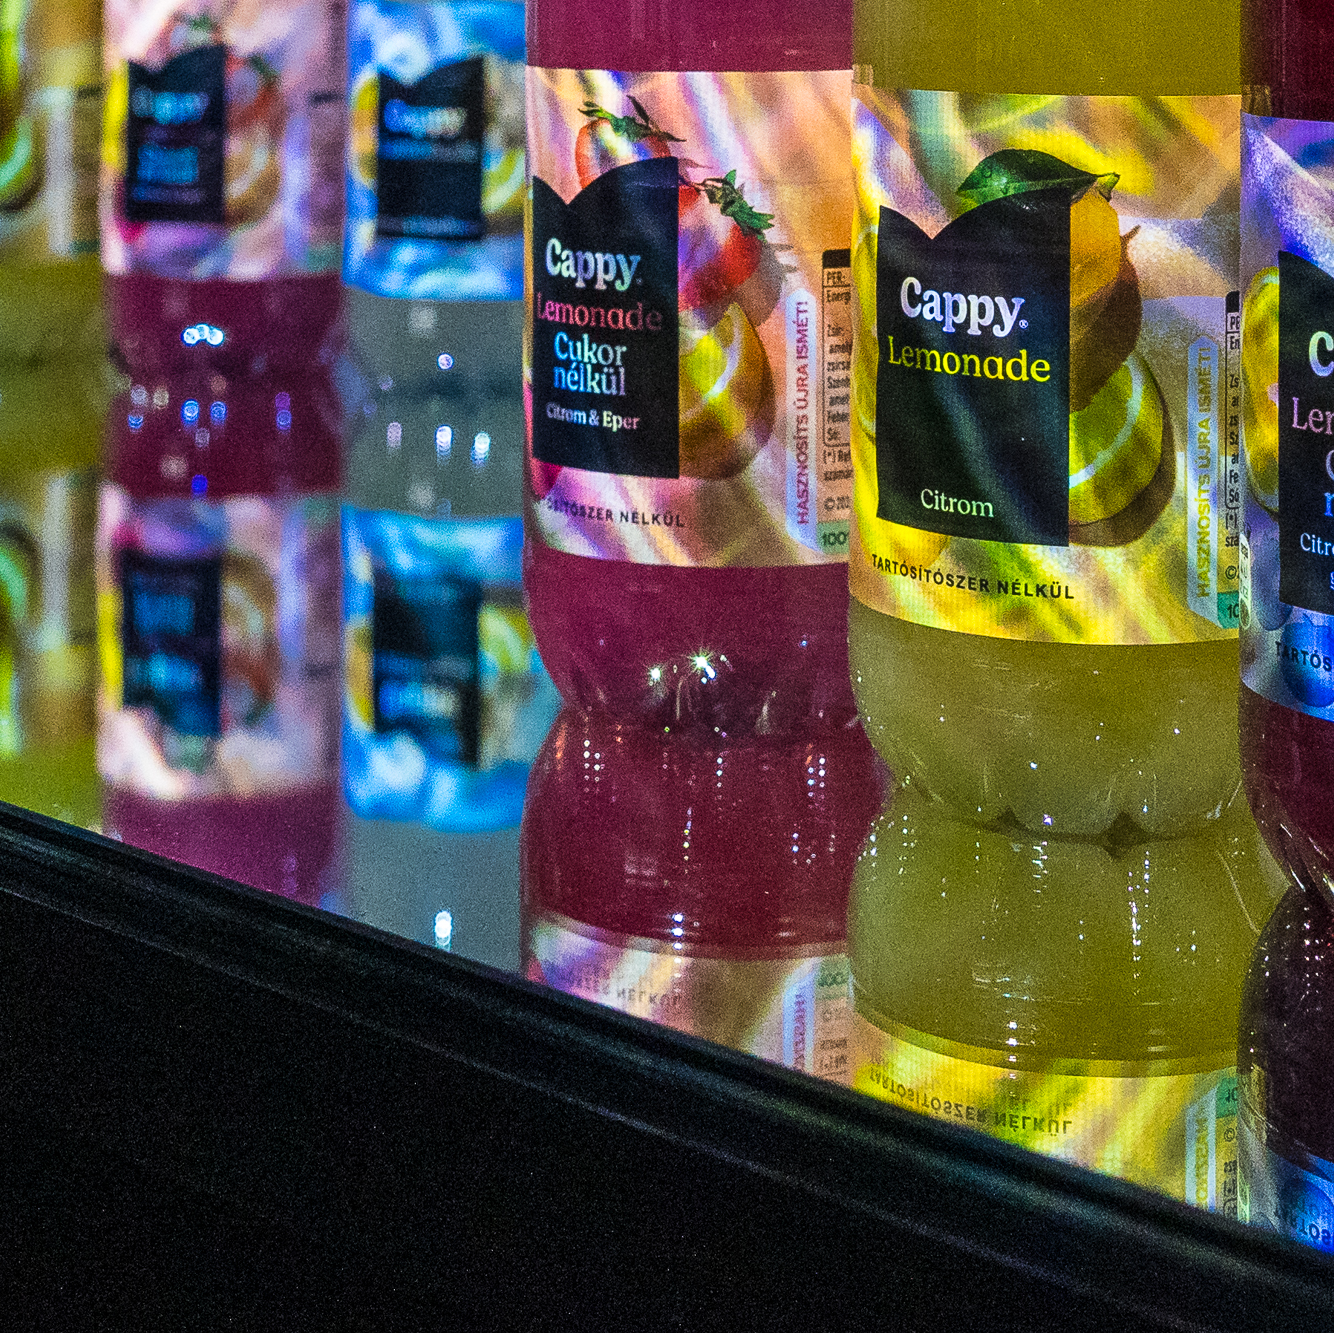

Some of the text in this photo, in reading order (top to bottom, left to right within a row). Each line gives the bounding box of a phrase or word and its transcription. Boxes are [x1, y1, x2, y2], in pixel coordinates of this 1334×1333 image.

[537, 291, 662, 331] Lemonade
[554, 331, 627, 366] Cukor
[887, 335, 1051, 382] Lemonade
[553, 362, 626, 396] nélkül
[546, 401, 641, 432] Citrom & Eper
[920, 488, 994, 518] Citrom
[1194, 474, 1211, 598] HASZNOSÍTS
[871, 553, 1075, 600] TARTÓSÍTÓSZER NÉLKÜL
